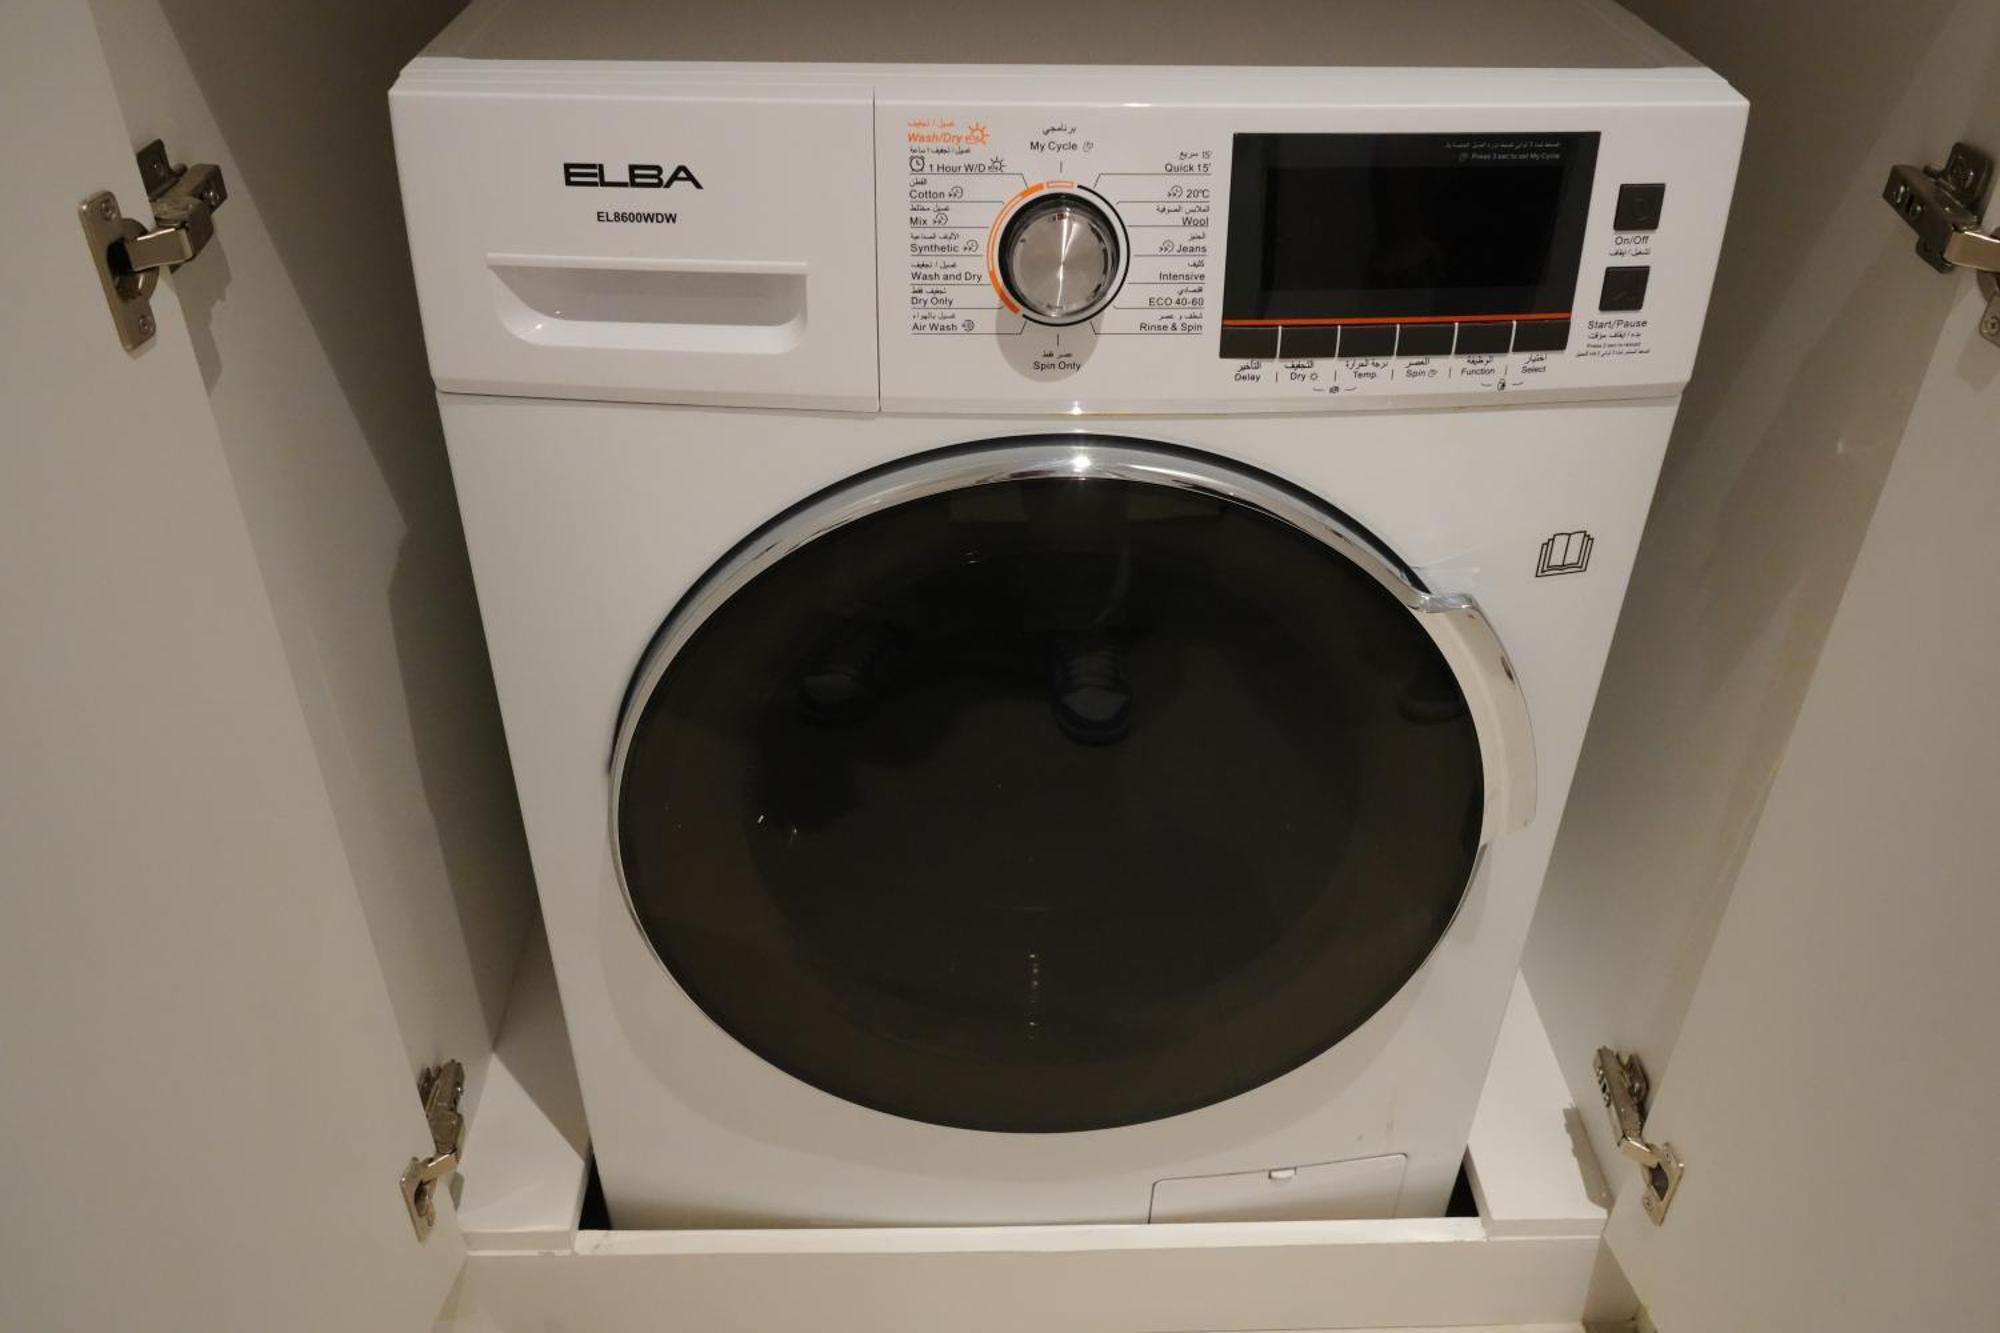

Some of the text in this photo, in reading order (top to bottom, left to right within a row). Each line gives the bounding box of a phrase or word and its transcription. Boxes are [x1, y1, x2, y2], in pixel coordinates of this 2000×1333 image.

[907, 132, 962, 145] Wash/Dry
[1030, 141, 1078, 153] My Cycle
[936, 163, 962, 173] Hour
[964, 163, 986, 173] W/D
[1164, 162, 1194, 173] Quick
[563, 163, 704, 190] ELBA
[909, 189, 945, 199] Cotton
[596, 211, 678, 225] EL8600WDW
[909, 216, 928, 226] Mix
[1182, 216, 1209, 228] Wool
[1614, 235, 1650, 246] On/Off
[910, 243, 960, 254] Synthetic
[1176, 243, 1207, 254] Jeans
[911, 271, 983, 283] Wash and Dry
[1159, 272, 1206, 281] Intensive
[911, 296, 954, 308] Dry Only
[1148, 297, 1205, 307] ECO 40-60
[912, 322, 958, 332] Air Wash
[1139, 321, 1203, 333] Rinse & Spin
[1587, 319, 1648, 330] Start/Pause
[1033, 360, 1082, 372] Spin Only
[1461, 367, 1496, 376] Function
[1520, 366, 1547, 375] Select
[1234, 372, 1262, 383] Delay
[1290, 372, 1307, 382] Dry
[1353, 371, 1377, 380] Temp
[1405, 369, 1426, 379] Spin
